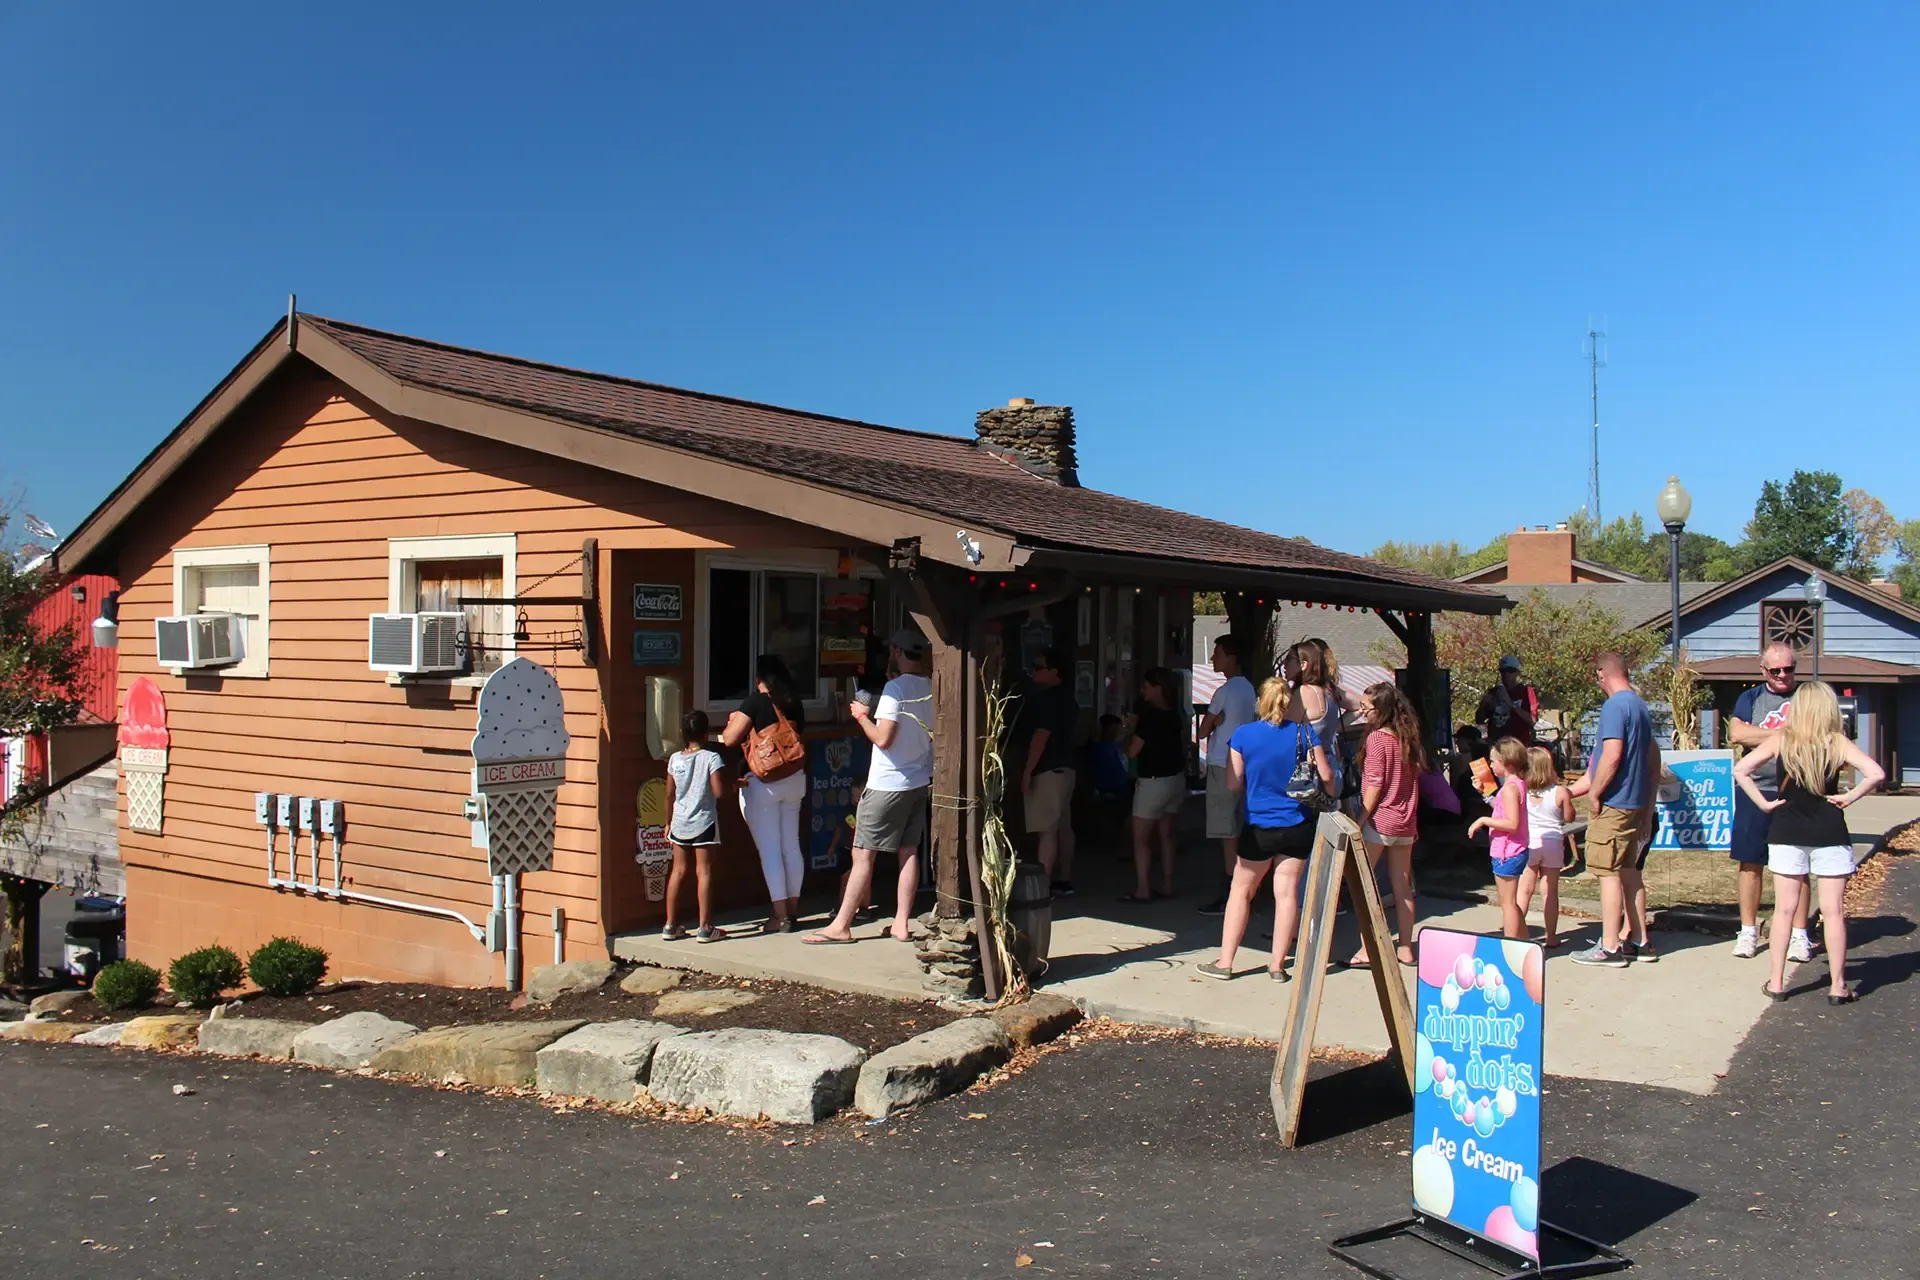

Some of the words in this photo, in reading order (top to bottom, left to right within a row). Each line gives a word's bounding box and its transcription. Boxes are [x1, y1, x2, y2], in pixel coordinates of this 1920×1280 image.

[124, 750, 136, 762] ICE
[139, 750, 164, 765] CREAM
[484, 766, 507, 782] ICE
[511, 762, 556, 779] CREAM
[1692, 764, 1727, 776] Serving
[813, 776, 828, 789] Ice
[830, 775, 853, 788] Crea
[1683, 778, 1715, 796] Soft
[1685, 793, 1728, 807] Serve
[1655, 803, 1730, 825] Frozen
[1655, 822, 1731, 846] Treats
[1424, 1005, 1524, 1052] dippin'
[1466, 1051, 1535, 1095] dots
[1431, 1126, 1456, 1160] Ice
[1462, 1138, 1523, 1185] Cream
